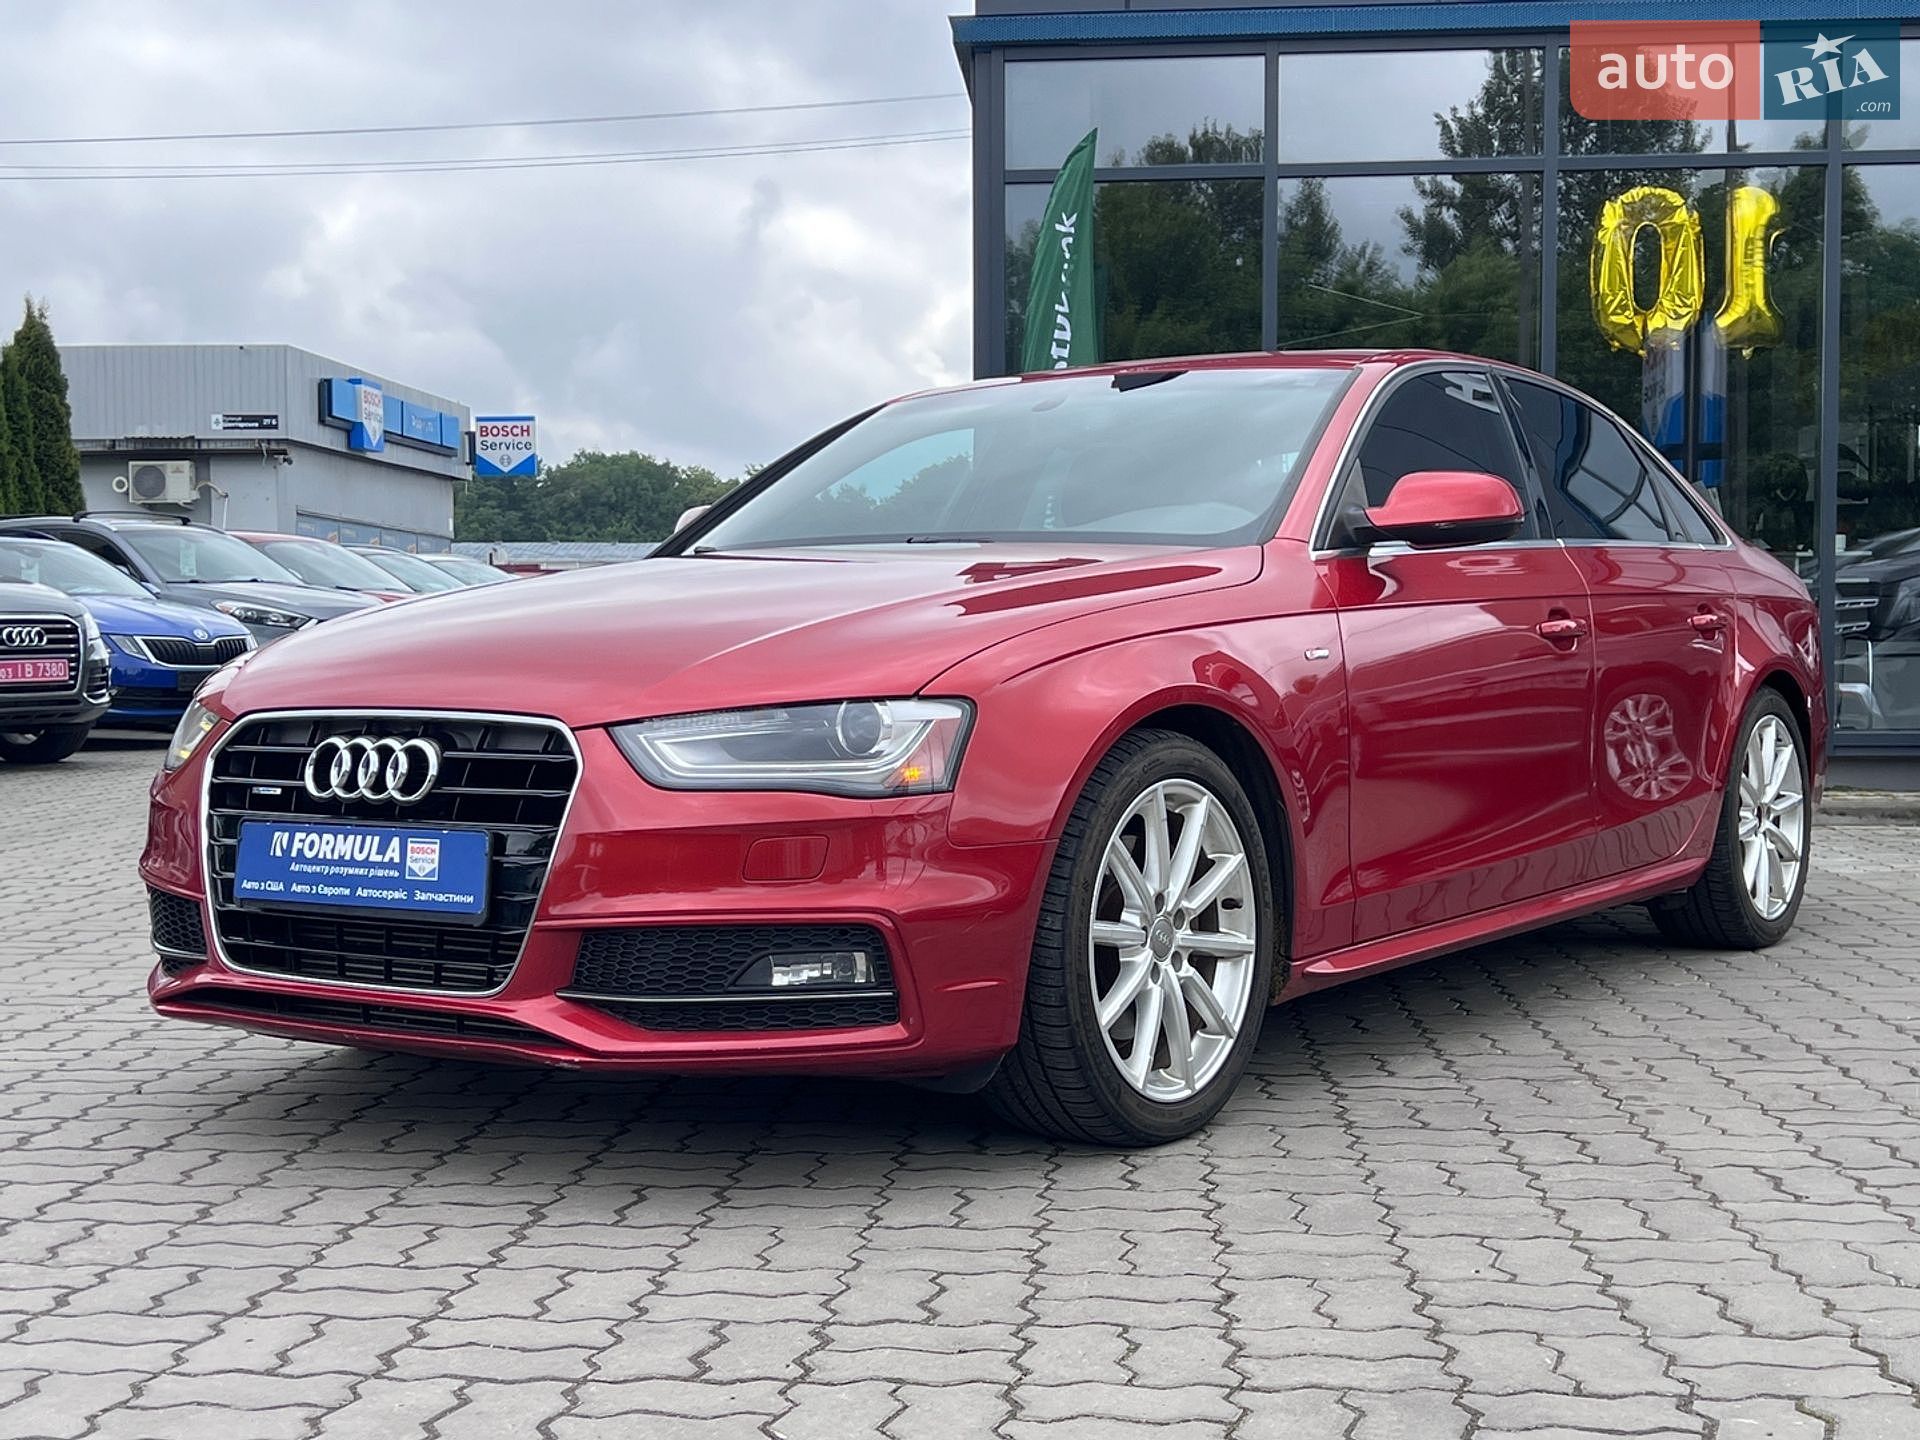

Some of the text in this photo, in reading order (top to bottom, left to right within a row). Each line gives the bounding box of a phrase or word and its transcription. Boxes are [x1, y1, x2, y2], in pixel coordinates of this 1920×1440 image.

[479, 425, 531, 437] BOSCH
[480, 439, 532, 451] Service
[37, 662, 64, 677] 7380
[290, 831, 400, 863] FORMULA
[410, 845, 437, 856] BOSCH
[409, 855, 436, 865] Service
[289, 861, 400, 878] Автоцентр розумних рішень
[241, 879, 260, 891] Авто
[265, 880, 285, 892] США
[290, 882, 311, 894] Авто
[317, 884, 351, 897] Європи
[355, 886, 408, 900] Автосервіс
[413, 890, 475, 904] Запчастини
